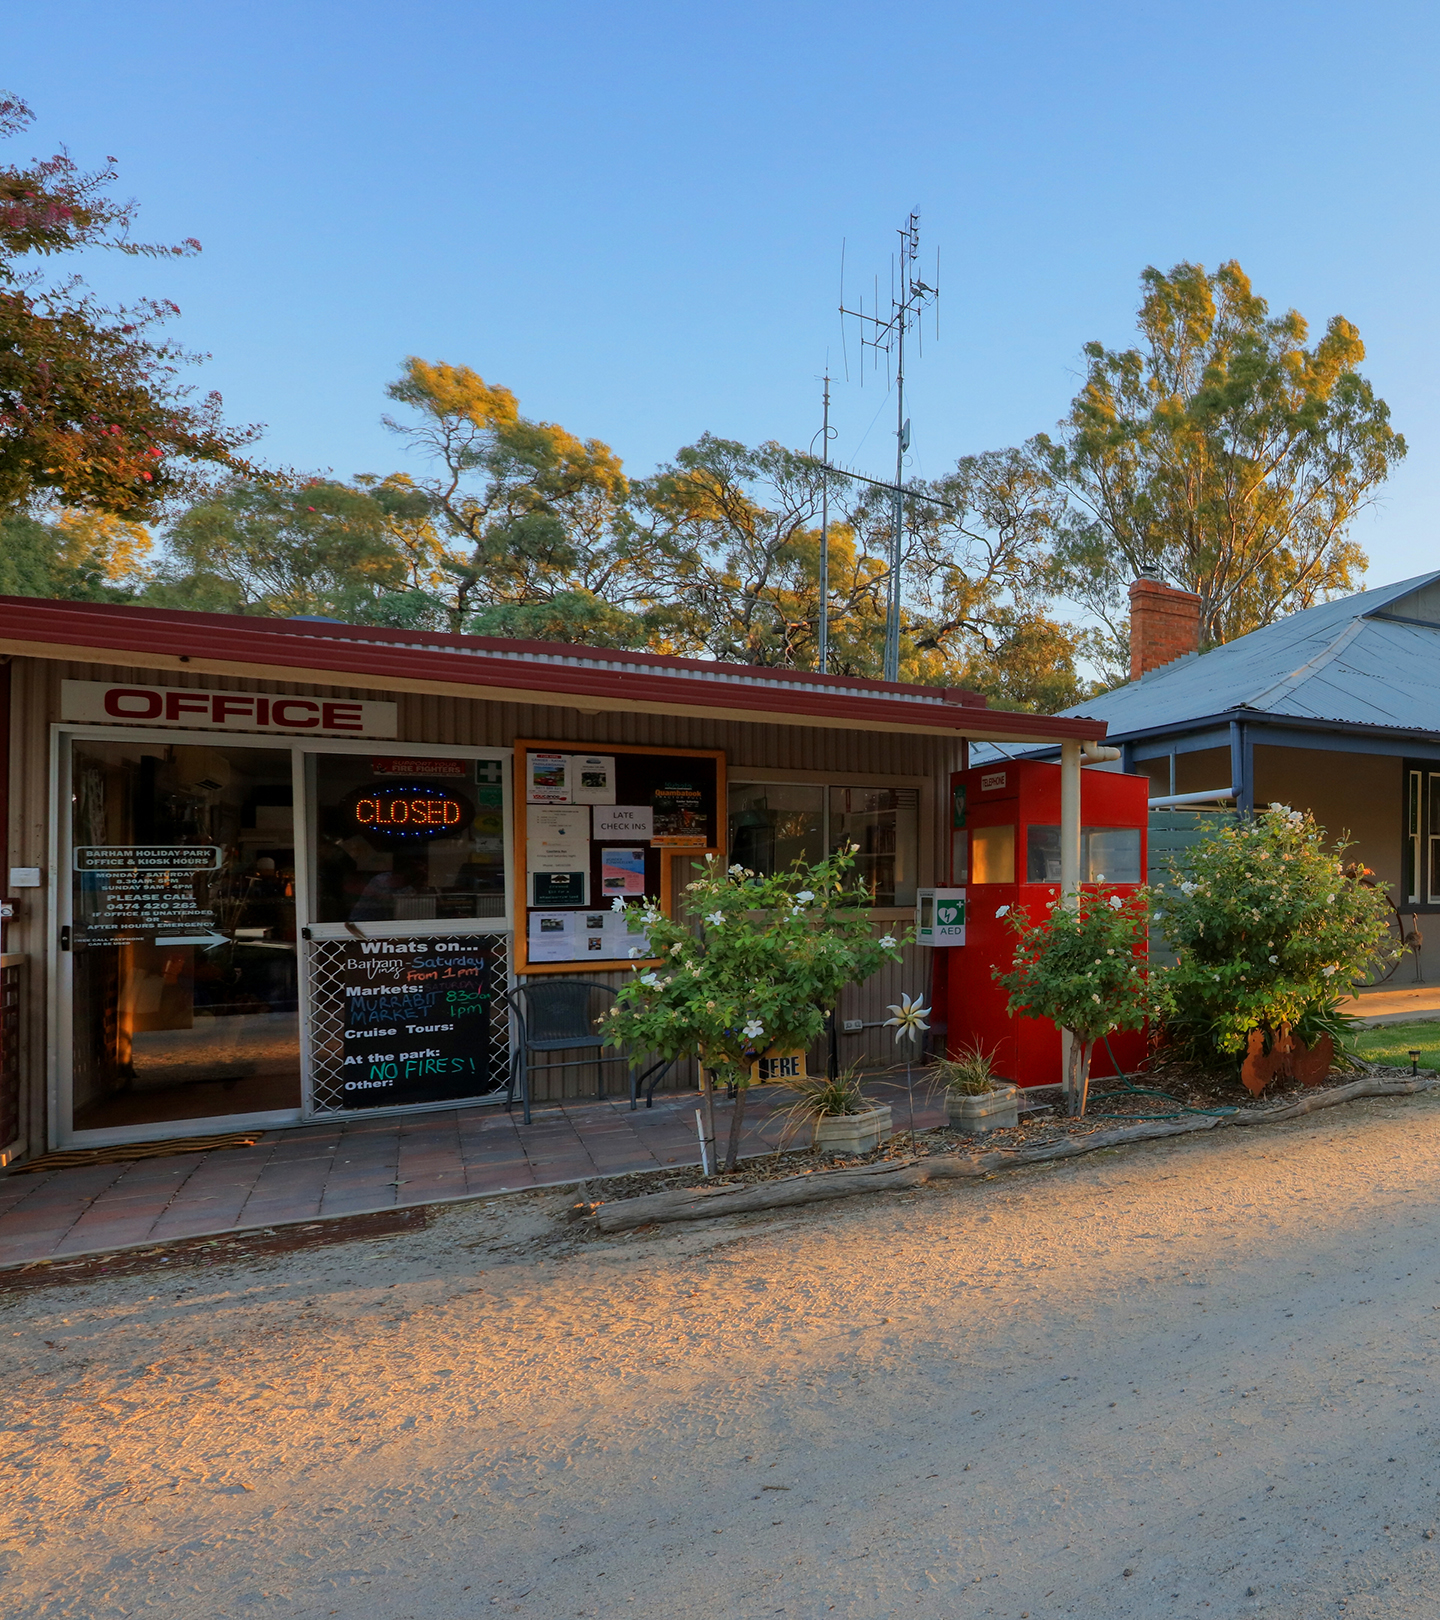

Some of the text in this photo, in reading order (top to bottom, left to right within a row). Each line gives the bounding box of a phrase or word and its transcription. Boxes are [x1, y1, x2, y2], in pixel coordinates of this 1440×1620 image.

[104, 688, 363, 731] OFFICE
[982, 775, 1005, 787] TELEPHONE
[655, 789, 702, 797] Quambatook
[356, 799, 461, 824] CLOSED
[940, 927, 962, 935] AED
[361, 941, 478, 954] Whats on...
[347, 958, 403, 970] Barham
[366, 961, 405, 980] Vines
[346, 984, 424, 997] Markets:
[424, 980, 484, 993] SATURDAY
[351, 990, 444, 1012] MURRABIT
[351, 1005, 432, 1025] MARKET
[344, 1023, 454, 1039] Cruise Tours:
[343, 1049, 440, 1066] At the park:
[370, 1062, 398, 1080] NO
[344, 1080, 393, 1091] Other:
